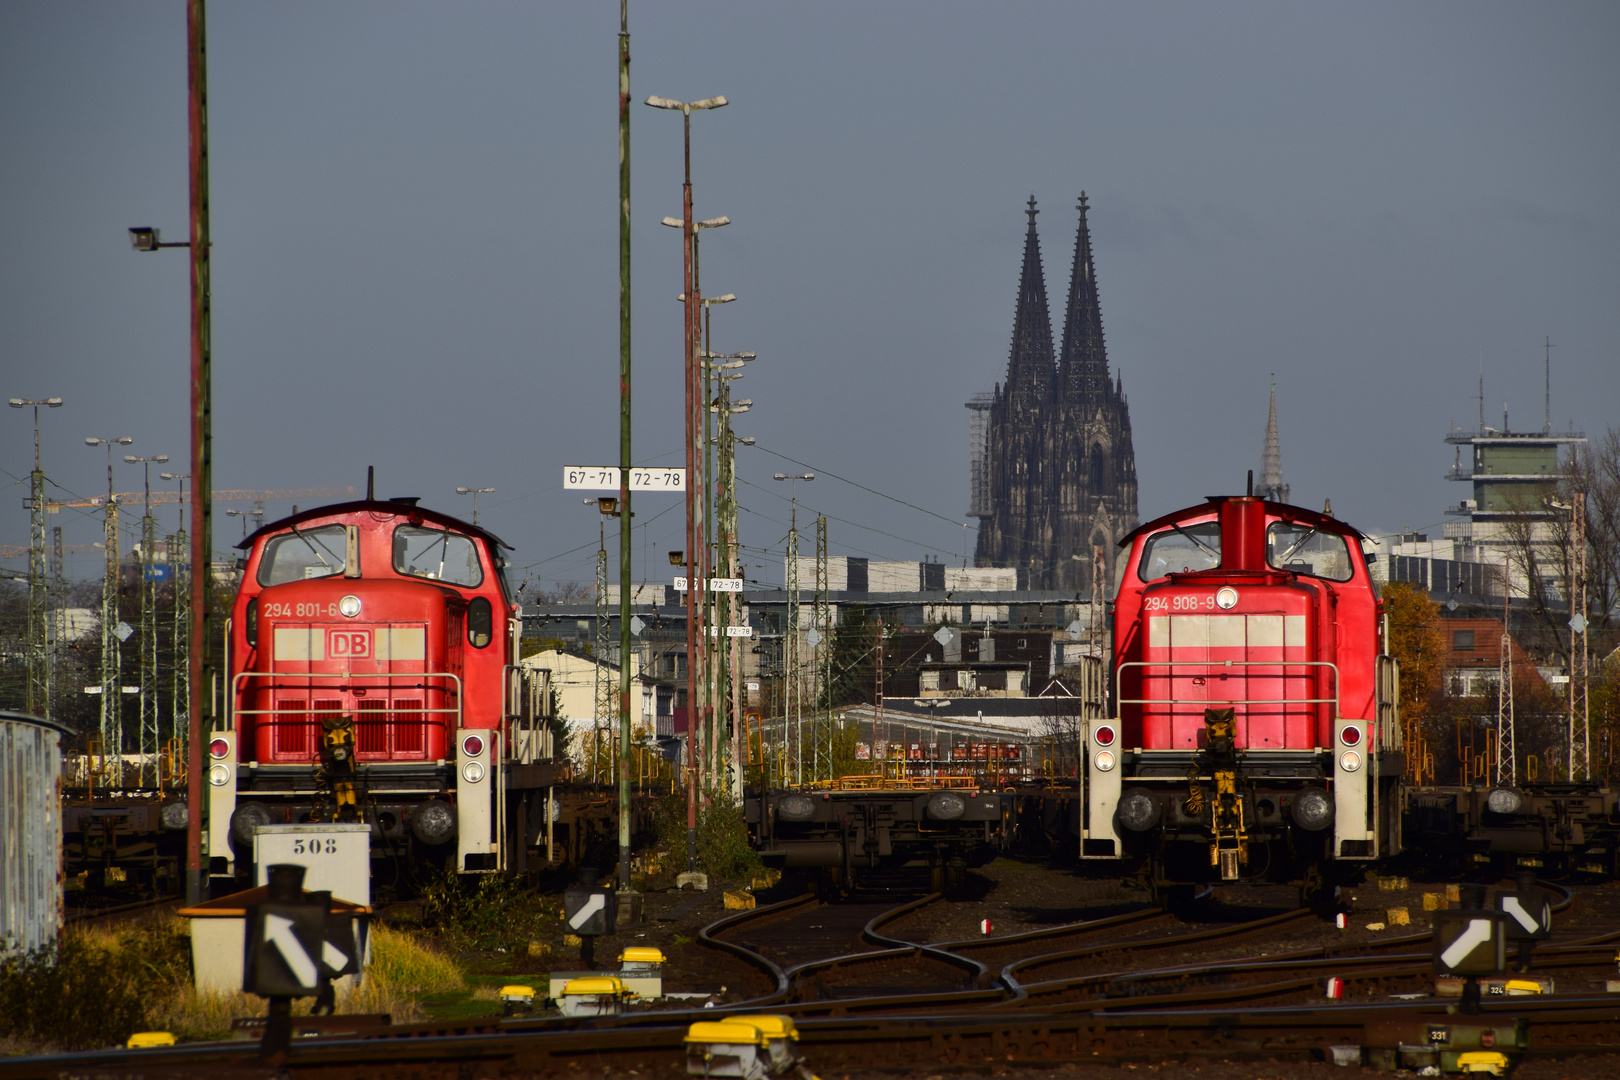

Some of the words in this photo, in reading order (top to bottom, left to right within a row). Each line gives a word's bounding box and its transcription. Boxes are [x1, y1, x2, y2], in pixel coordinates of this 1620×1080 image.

[569, 471, 613, 484] 67-71
[634, 473, 681, 486] 72-78
[713, 580, 740, 590] 72-78
[1144, 597, 1169, 610] 294
[1173, 596, 1215, 610] 908-9
[264, 603, 292, 617] 294
[296, 603, 337, 617] 801-6
[334, 634, 367, 655] DB
[293, 838, 337, 855] 508
[1490, 986, 1503, 994] 324
[1431, 1031, 1446, 1040] 331
